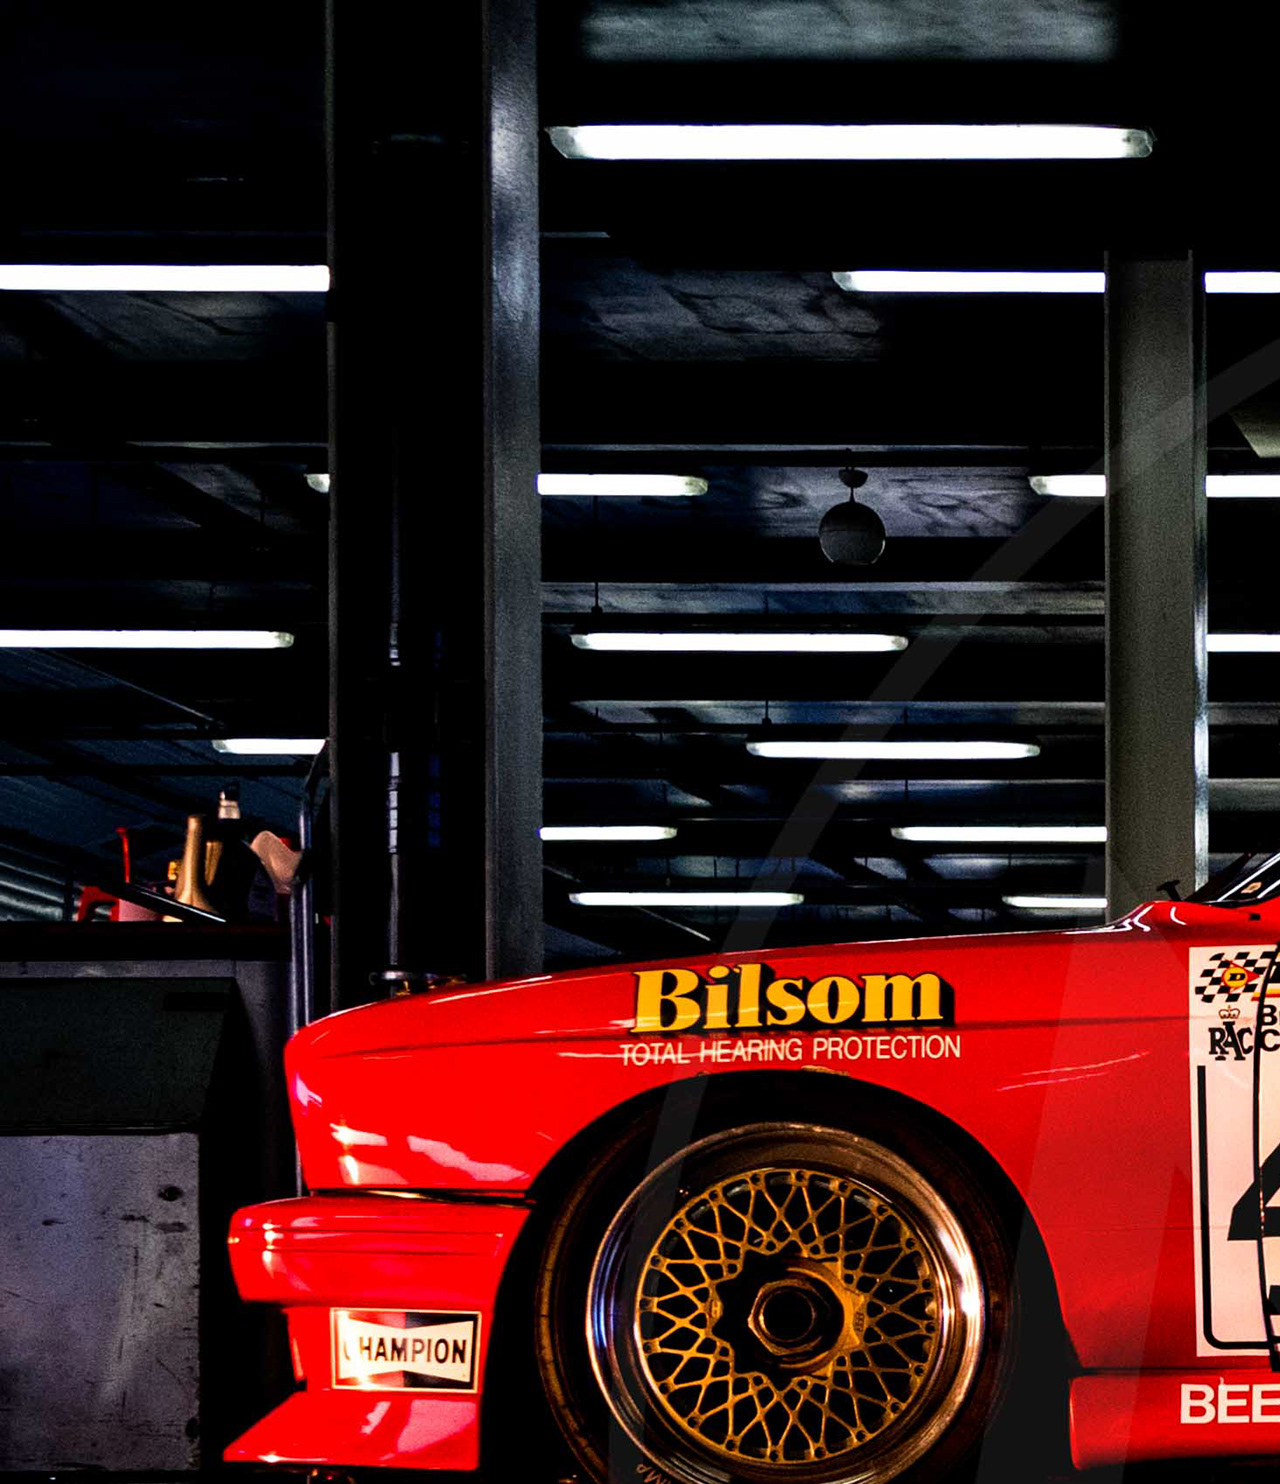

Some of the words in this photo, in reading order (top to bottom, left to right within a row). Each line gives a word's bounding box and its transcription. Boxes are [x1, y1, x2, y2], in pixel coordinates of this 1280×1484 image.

[629, 962, 949, 1034] Bilsom
[619, 1042, 691, 1067] TOTAL
[699, 1037, 803, 1063] HEARING
[812, 1034, 962, 1061] PROTECTION
[1208, 1021, 1254, 1061] RAC
